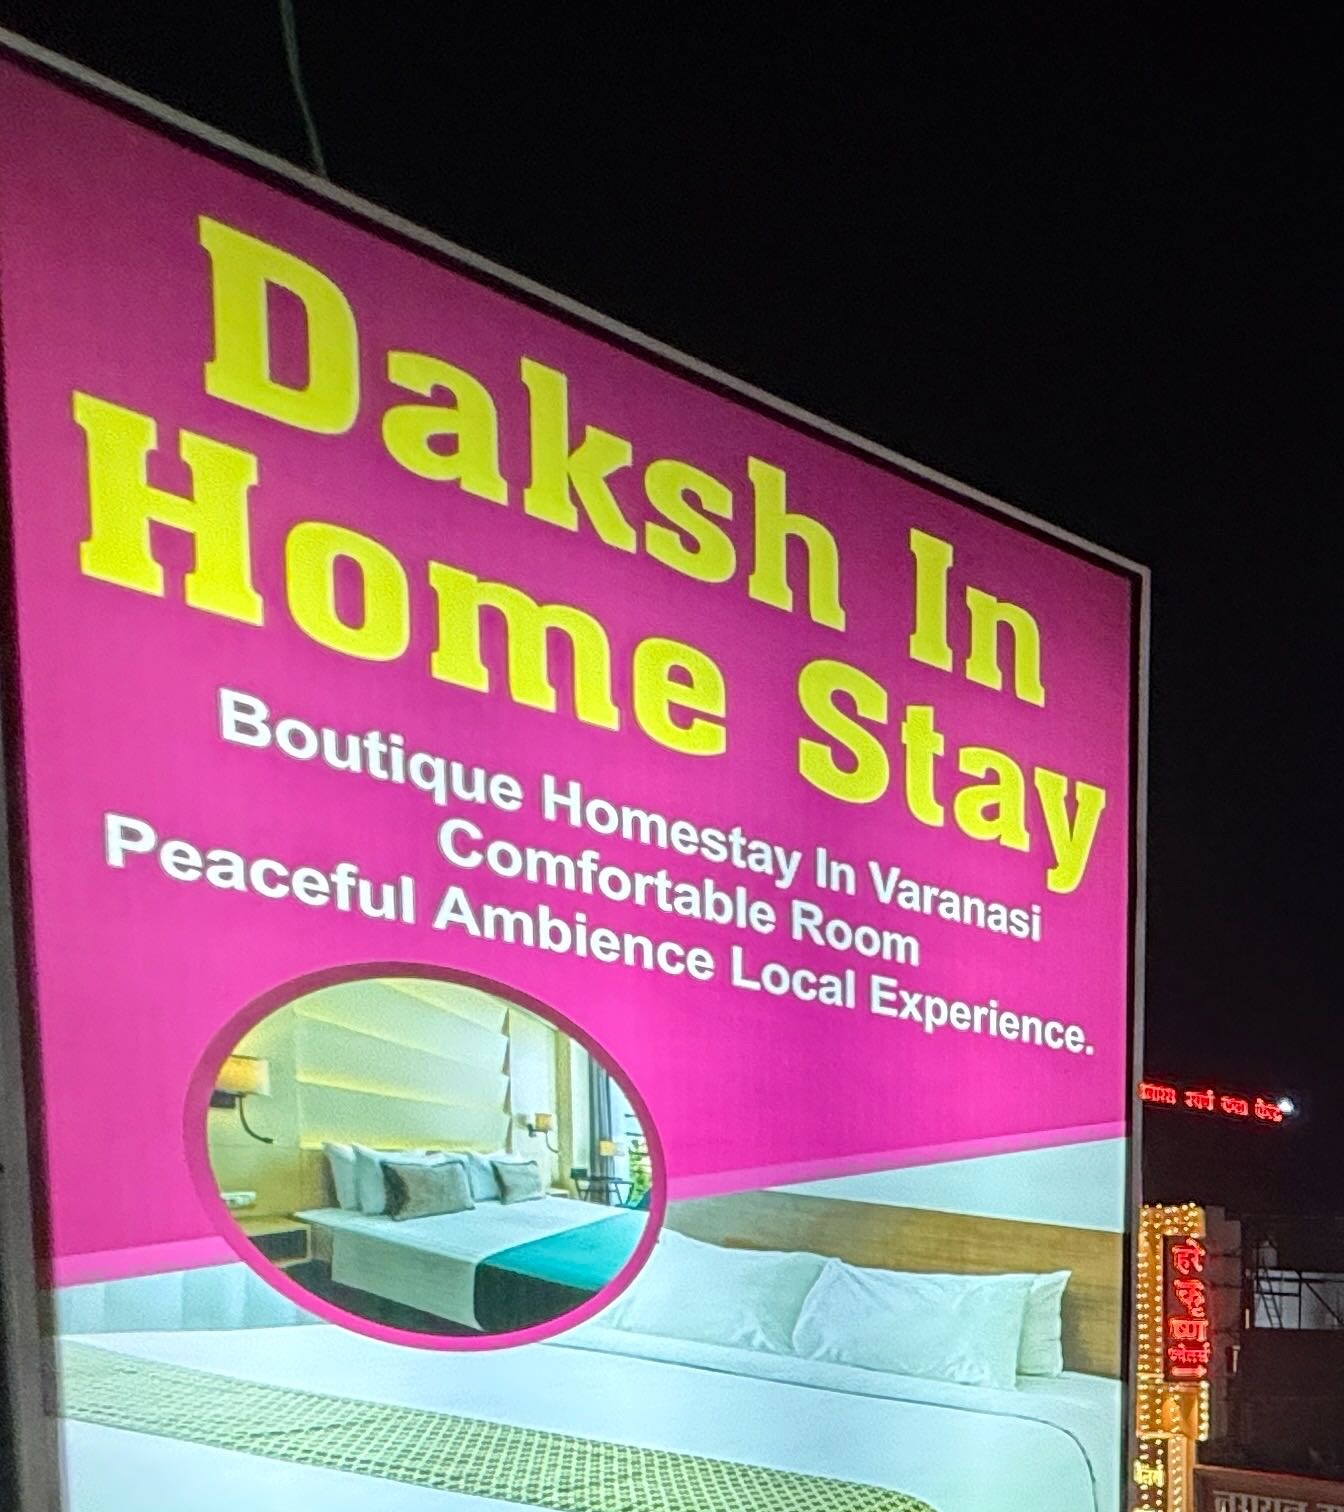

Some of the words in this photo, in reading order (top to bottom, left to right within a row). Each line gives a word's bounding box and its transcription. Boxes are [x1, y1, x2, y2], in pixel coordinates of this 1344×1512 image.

[199, 216, 845, 630] Daksh
[909, 528, 1045, 704] In
[72, 391, 726, 755] Home
[798, 659, 1104, 892] Stay
[104, 812, 417, 926] Peaceful
[431, 885, 716, 984] Ambience
[730, 945, 856, 1010] Local
[869, 980, 1096, 1056] Experience.
[218, 687, 525, 811] Boutique
[541, 773, 803, 890] Homestay
[816, 846, 857, 896] In
[868, 860, 1043, 943] Varanasi
[437, 818, 777, 936] Comfortable
[791, 899, 922, 968] Room
